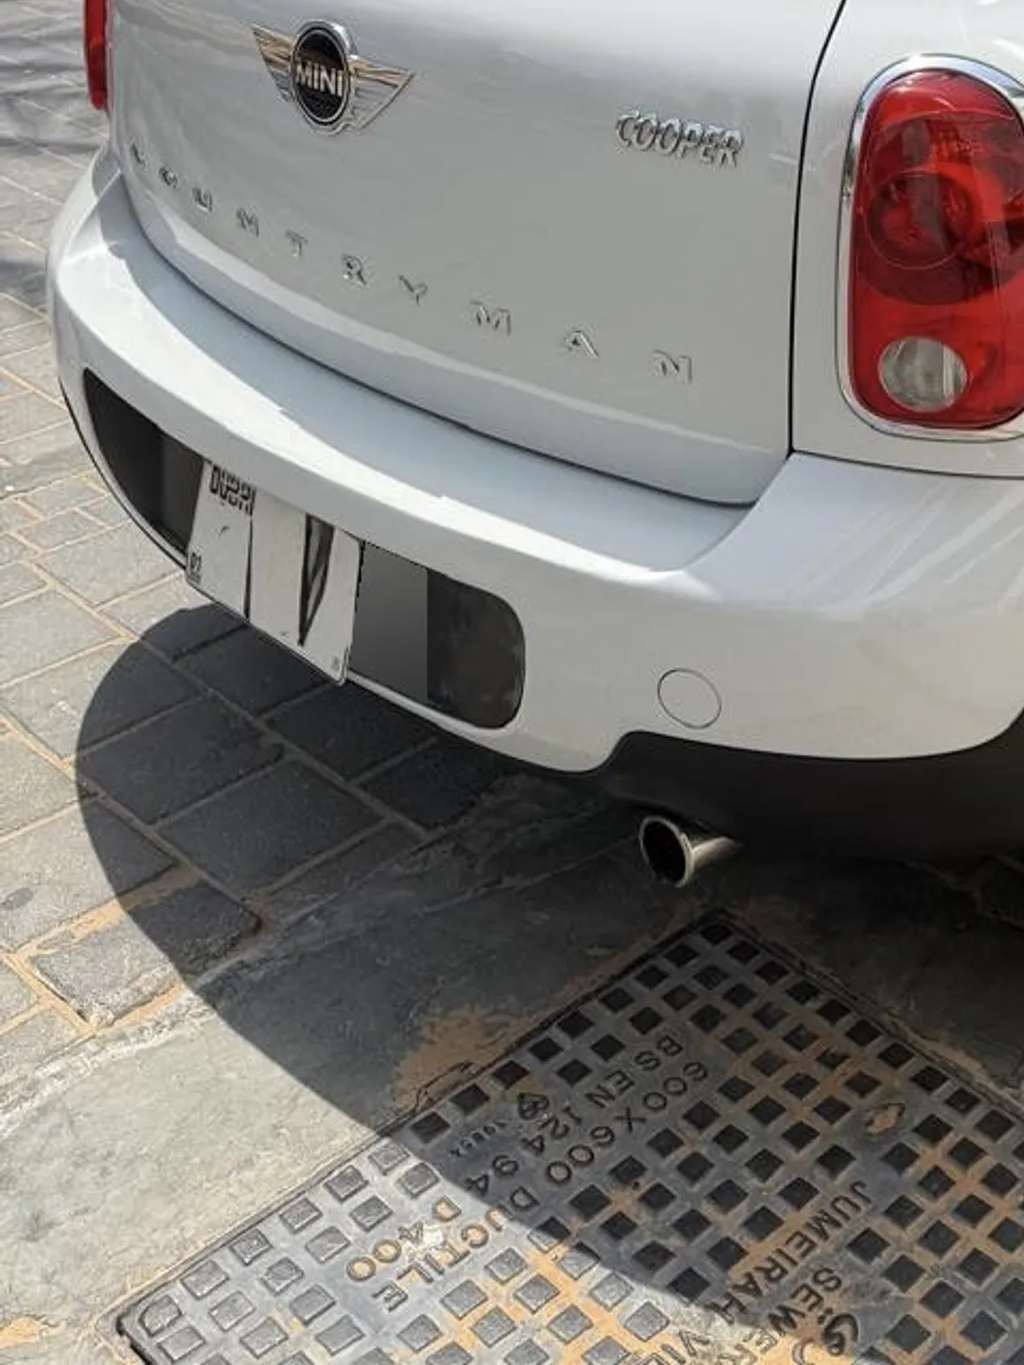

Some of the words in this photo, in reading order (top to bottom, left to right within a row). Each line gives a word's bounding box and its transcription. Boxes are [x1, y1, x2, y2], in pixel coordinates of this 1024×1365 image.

[296, 61, 343, 97] MINI
[615, 111, 744, 169] COOPER
[634, 1034, 684, 1071] BS
[584, 1069, 635, 1109] EN
[520, 1105, 583, 1154] 124
[371, 1185, 541, 1312] DUCTILE
[706, 1180, 872, 1325] JUMEIRAH
